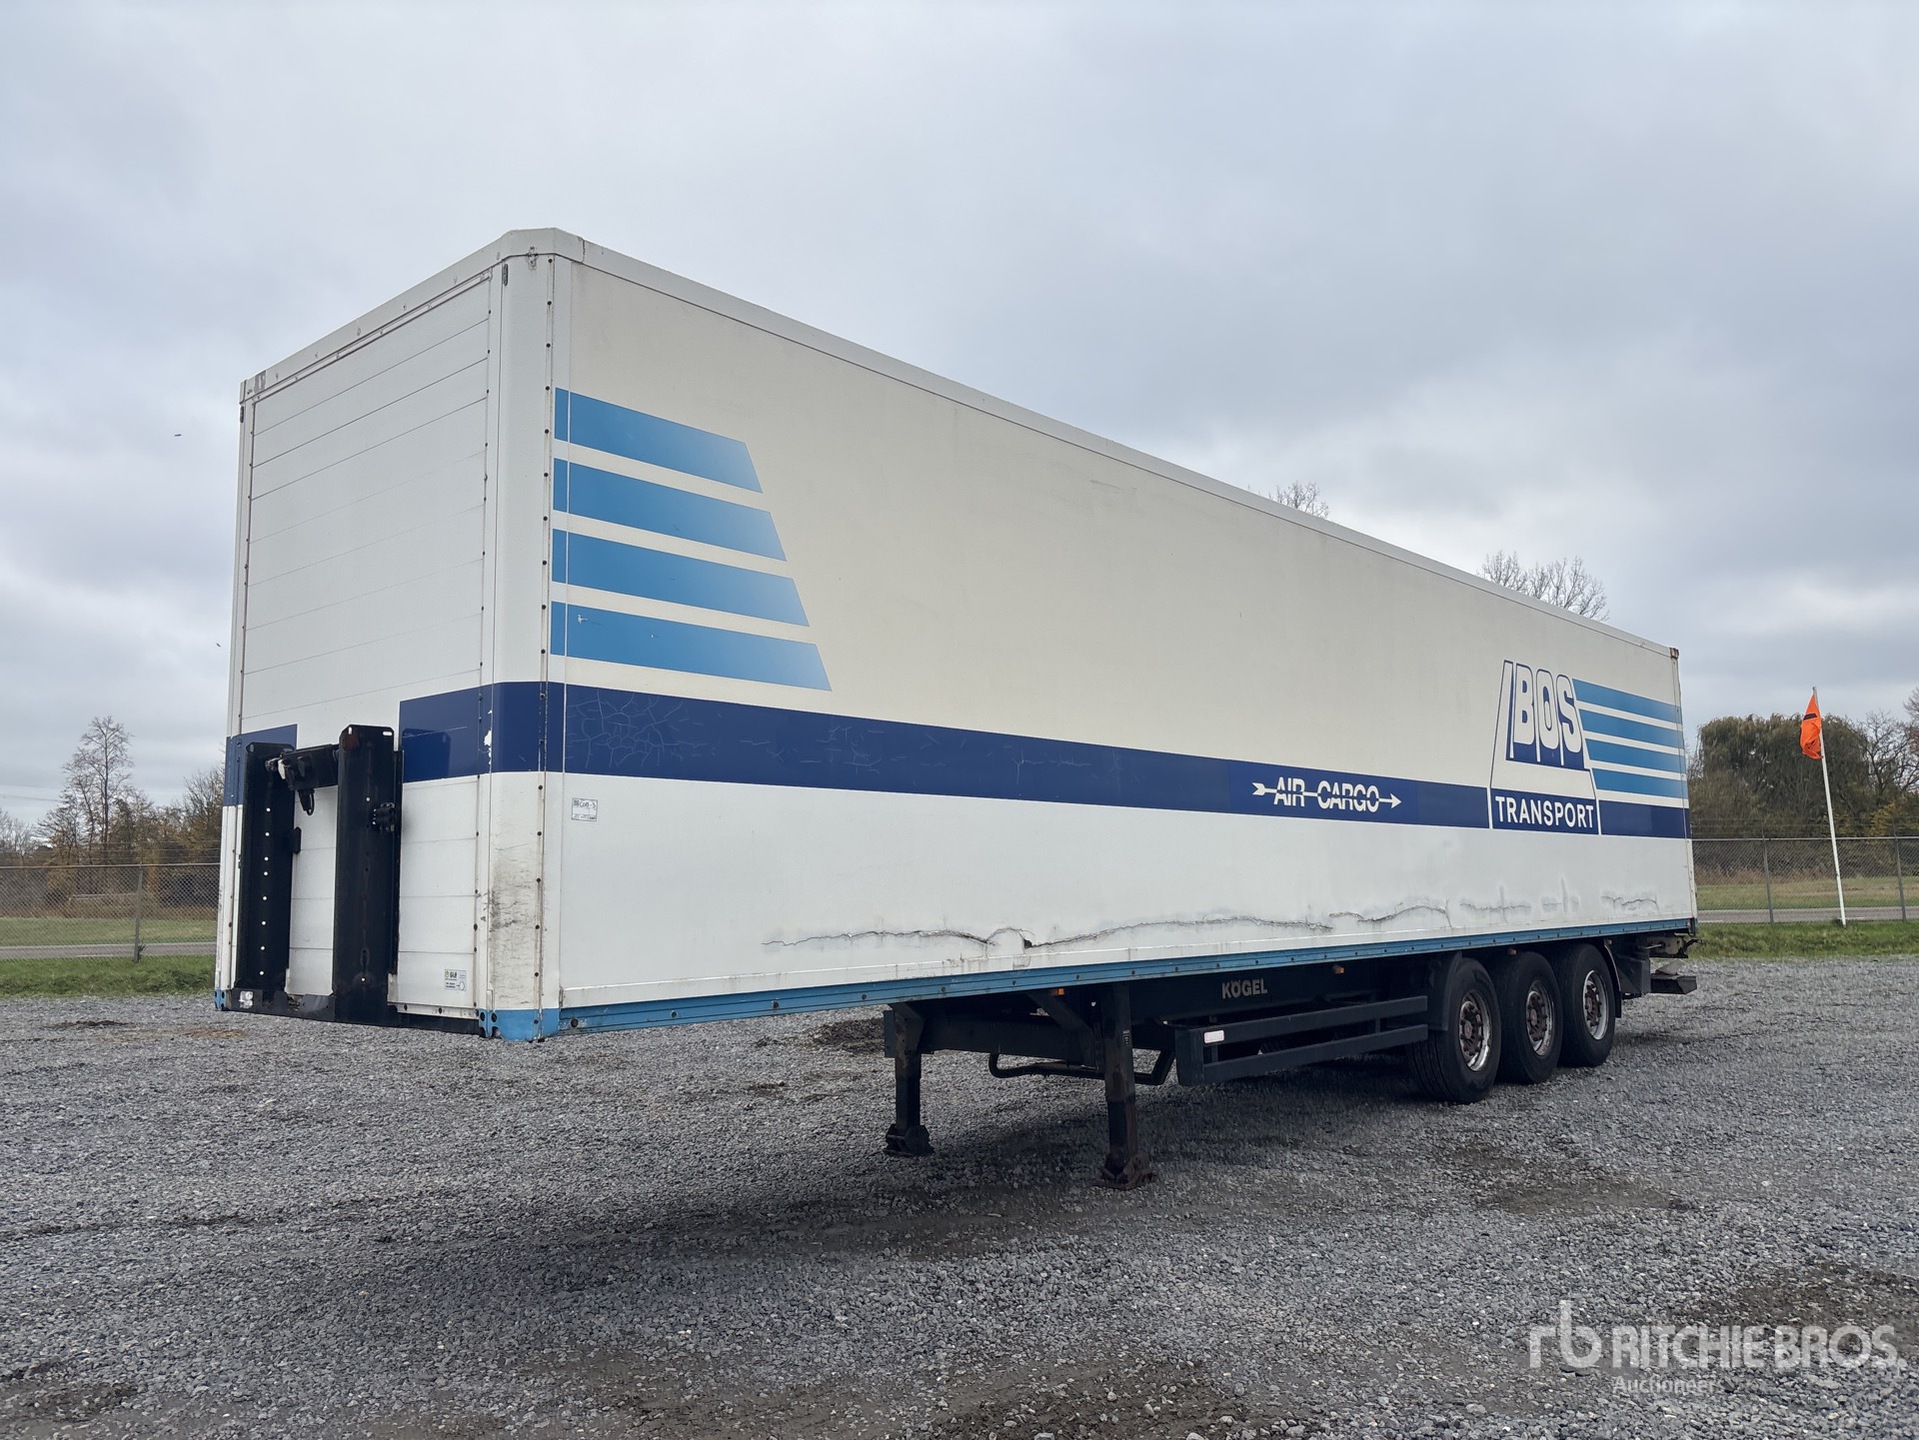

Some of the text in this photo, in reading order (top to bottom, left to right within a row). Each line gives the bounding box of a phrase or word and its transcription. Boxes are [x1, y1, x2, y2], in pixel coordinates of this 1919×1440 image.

[1273, 776, 1381, 813] AIR CARGO
[1494, 795, 1595, 829] TRANSPORT
[1221, 978, 1268, 999] KÖGEL
